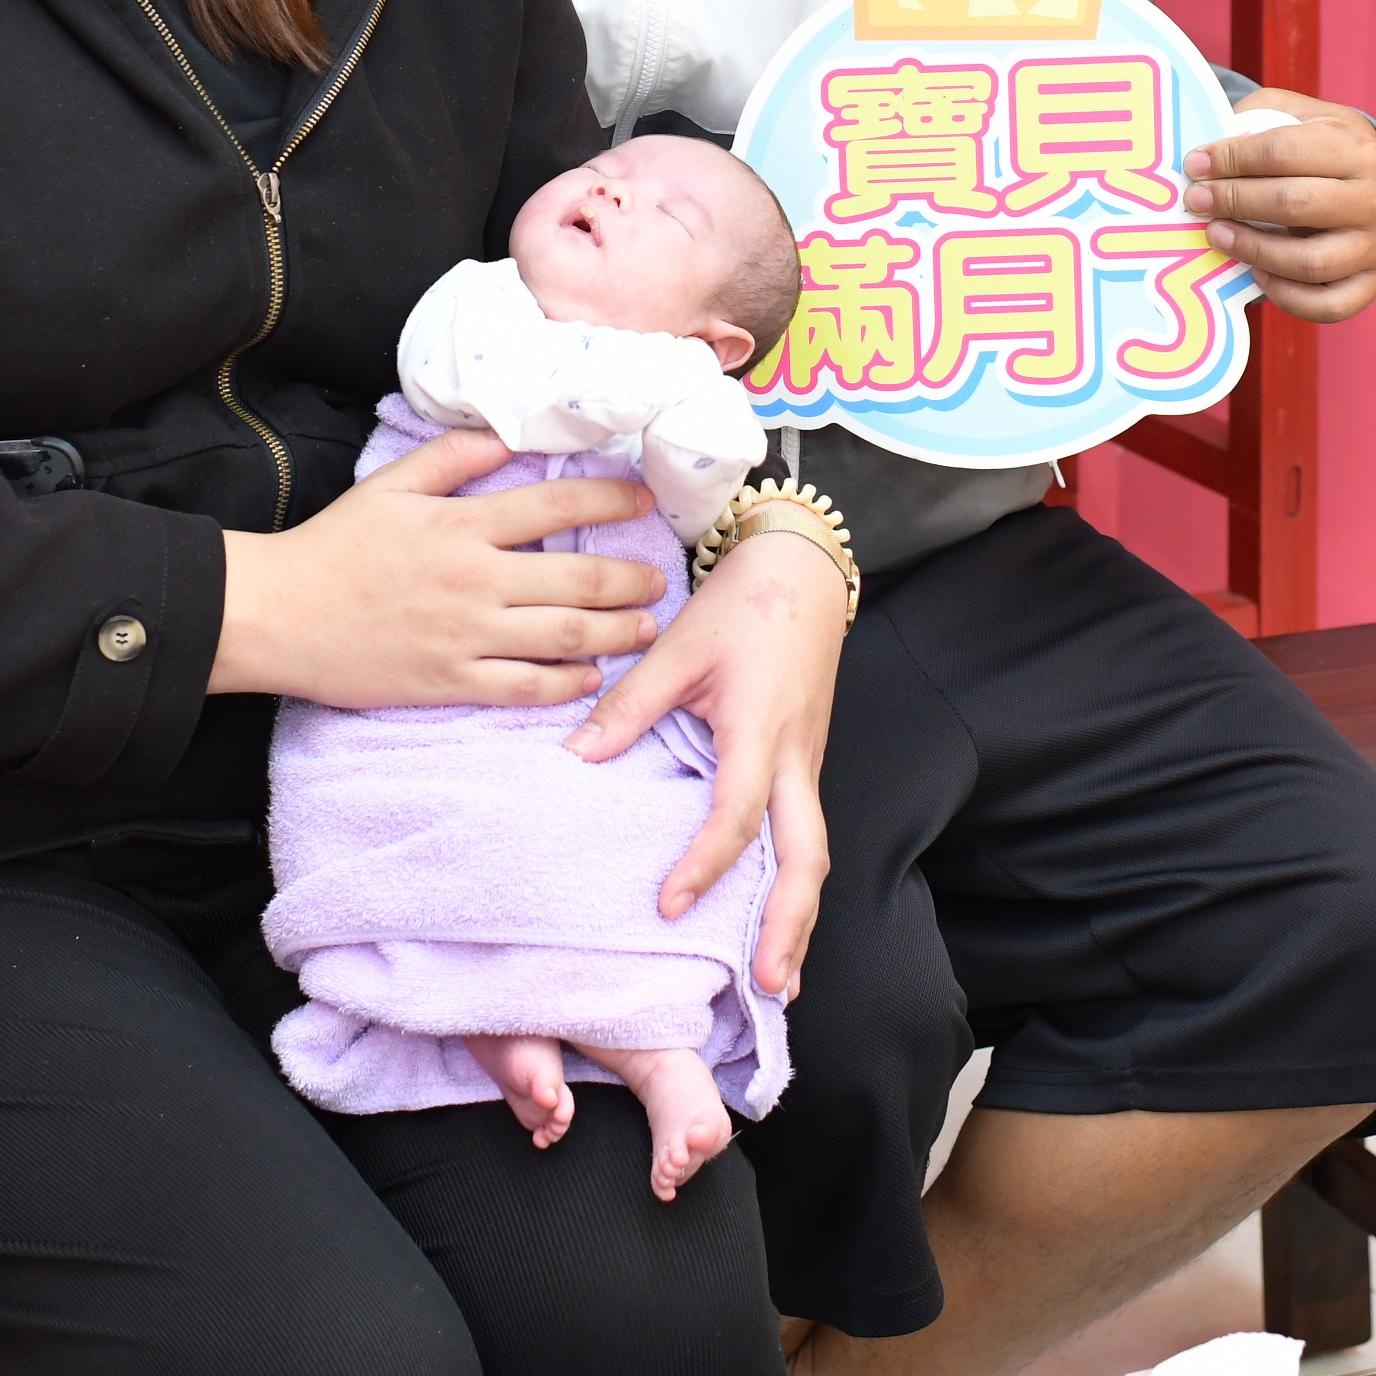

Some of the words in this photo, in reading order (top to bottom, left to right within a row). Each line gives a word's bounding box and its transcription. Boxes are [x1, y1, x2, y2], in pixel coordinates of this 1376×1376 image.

[821, 54, 1179, 224] 寶貝
[743, 221, 1237, 395] 滿月了
